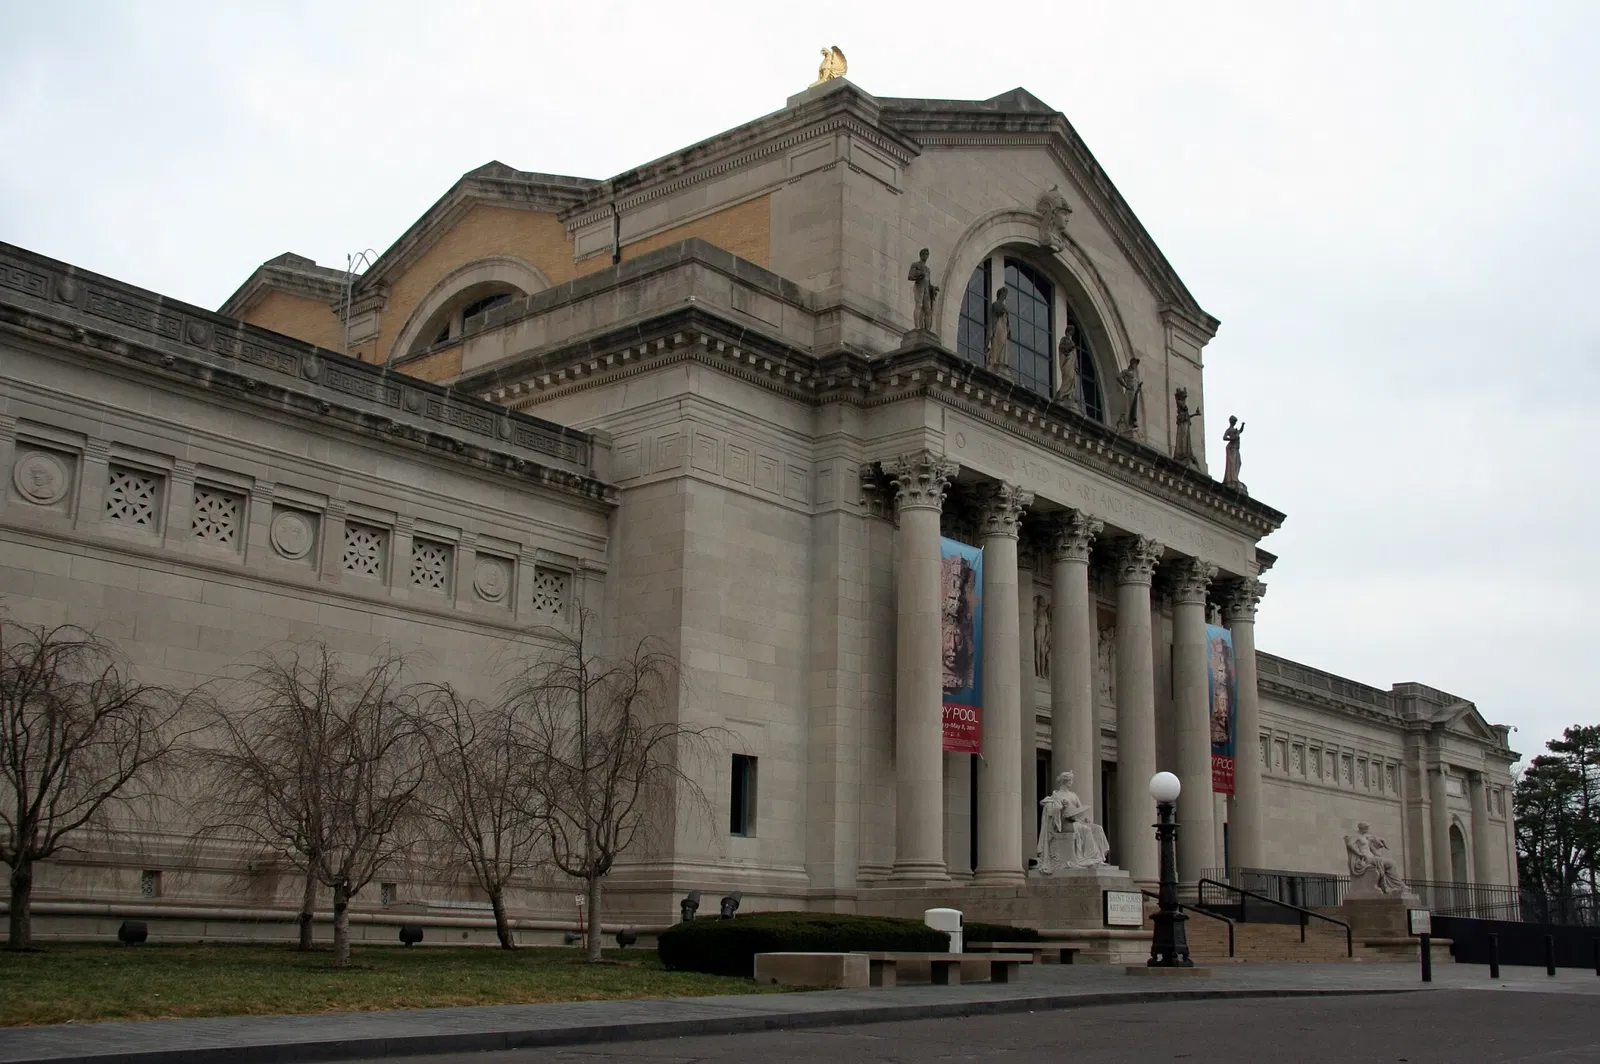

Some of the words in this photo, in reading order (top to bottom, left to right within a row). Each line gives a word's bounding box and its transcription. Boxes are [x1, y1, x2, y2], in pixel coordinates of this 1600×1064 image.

[980, 441, 1050, 483] DEDICATED
[1056, 472, 1072, 492] TO
[1076, 484, 1097, 504] ART
[1100, 491, 1122, 513] AND
[953, 707, 979, 723] POOL
